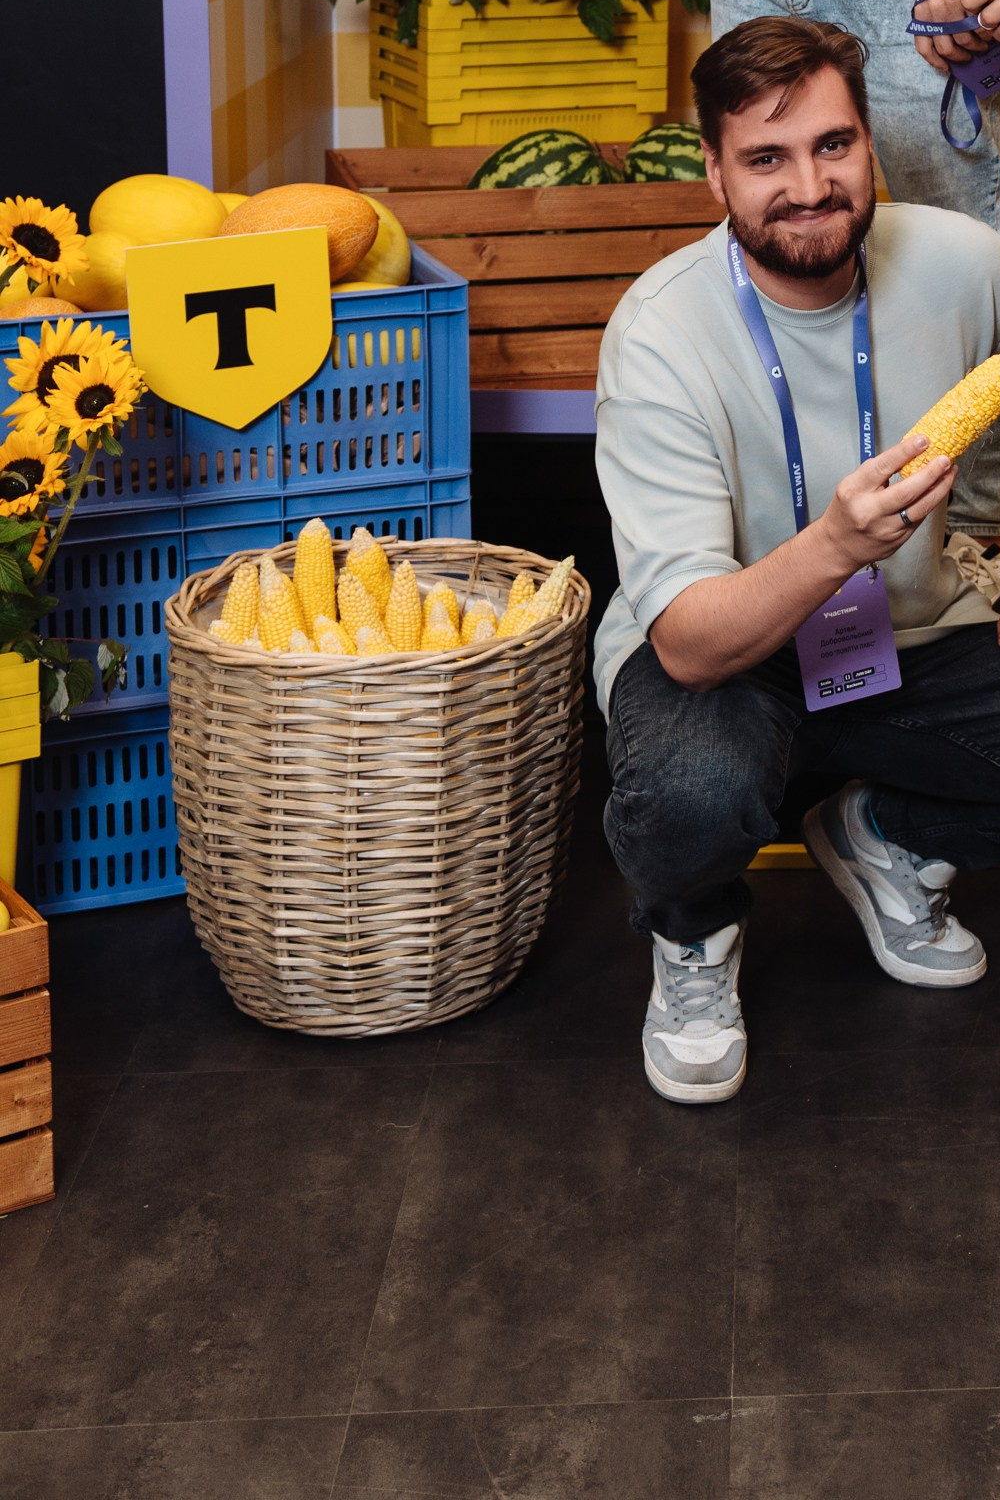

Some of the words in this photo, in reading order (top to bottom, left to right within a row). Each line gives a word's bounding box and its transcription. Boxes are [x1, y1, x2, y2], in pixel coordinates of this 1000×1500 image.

[909, 22, 926, 32] JVM
[926, 24, 943, 33] Day
[730, 242, 747, 287] Backend
[863, 410, 872, 431] Day
[863, 432, 872, 457] JVM
[792, 462, 802, 486] JVM
[795, 486, 803, 507] Day
[823, 605, 858, 618] Участник
